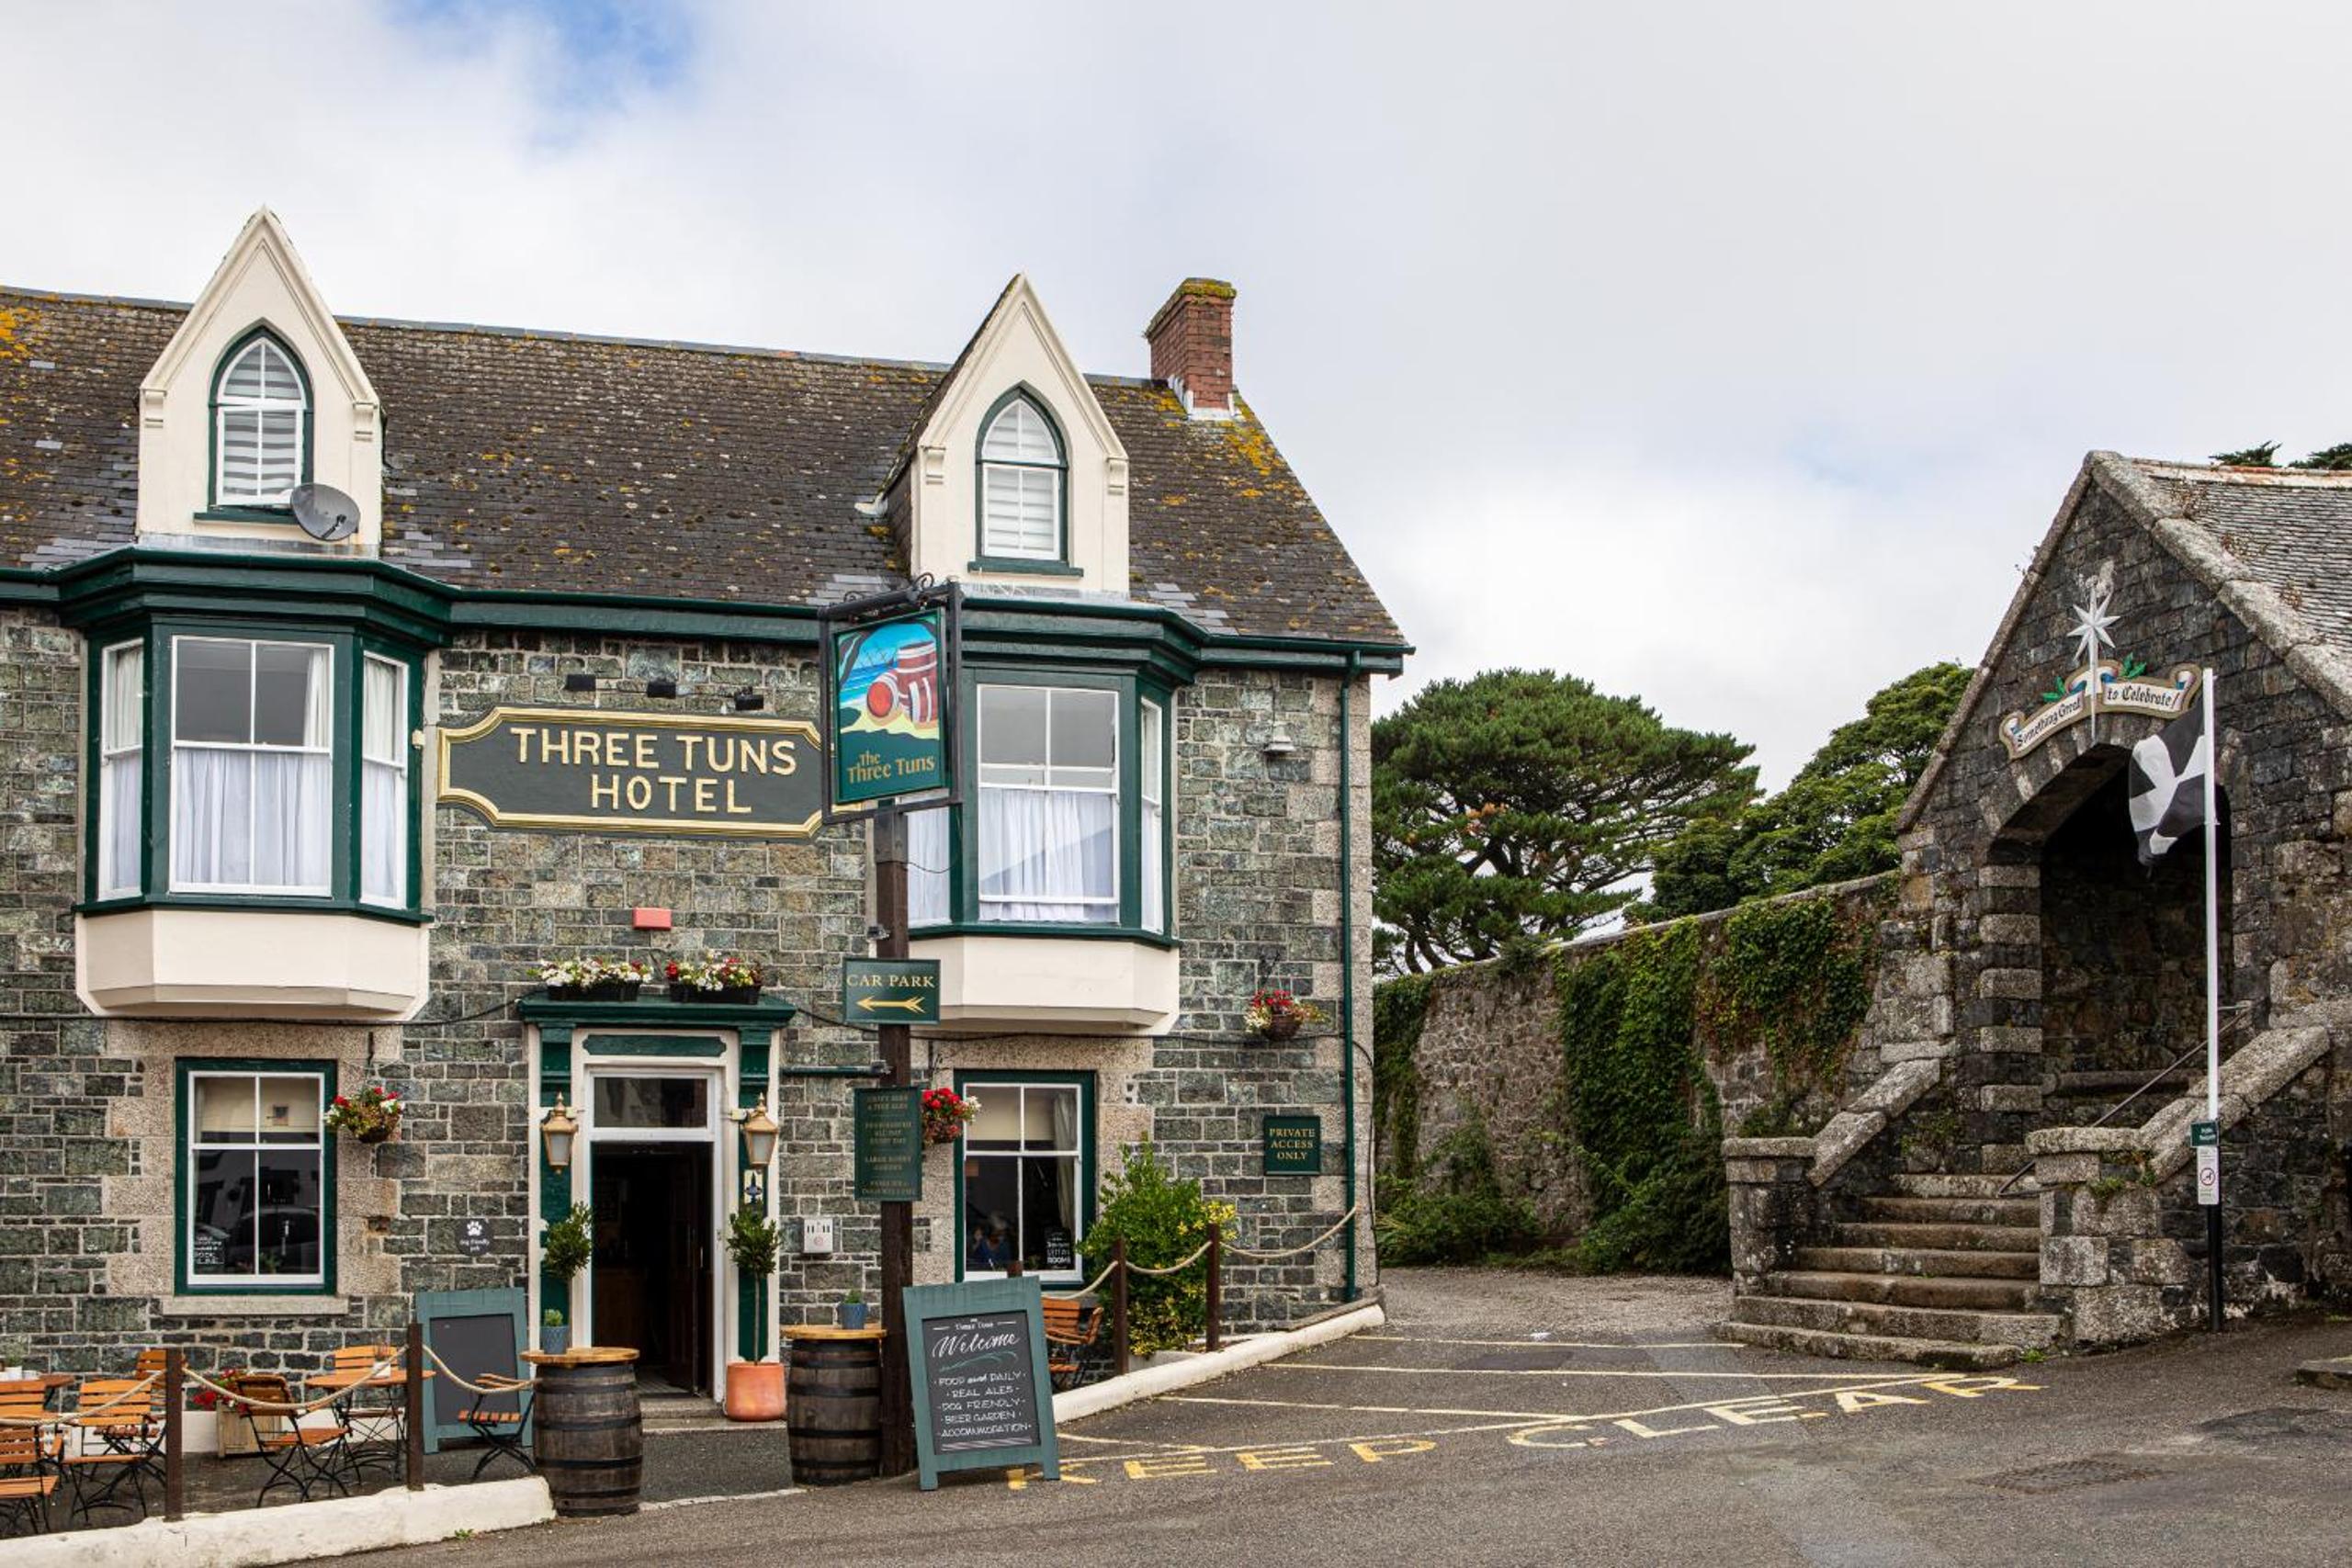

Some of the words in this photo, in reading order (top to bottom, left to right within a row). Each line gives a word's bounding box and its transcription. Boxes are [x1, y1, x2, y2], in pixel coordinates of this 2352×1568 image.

[510, 727, 660, 769] THREE
[675, 734, 797, 776] TUNS
[859, 750, 880, 766] The
[847, 761, 892, 784] Three
[895, 755, 936, 776] Tuns
[591, 773, 752, 814] HOTEL
[846, 974, 882, 987] CAR
[888, 974, 935, 988] PARK
[1269, 1127, 1316, 1138] PRIVATE
[1271, 1139, 1314, 1149] ACCESS
[1277, 1151, 1307, 1160] ONLY
[932, 1333, 1020, 1359] Welcome
[989, 1371, 1022, 1382] DAILY
[952, 1388, 980, 1398] REAL
[985, 1385, 1013, 1395] ALES
[944, 1415, 971, 1424] BEER
[1507, 1378, 2049, 1449] CLEAR
